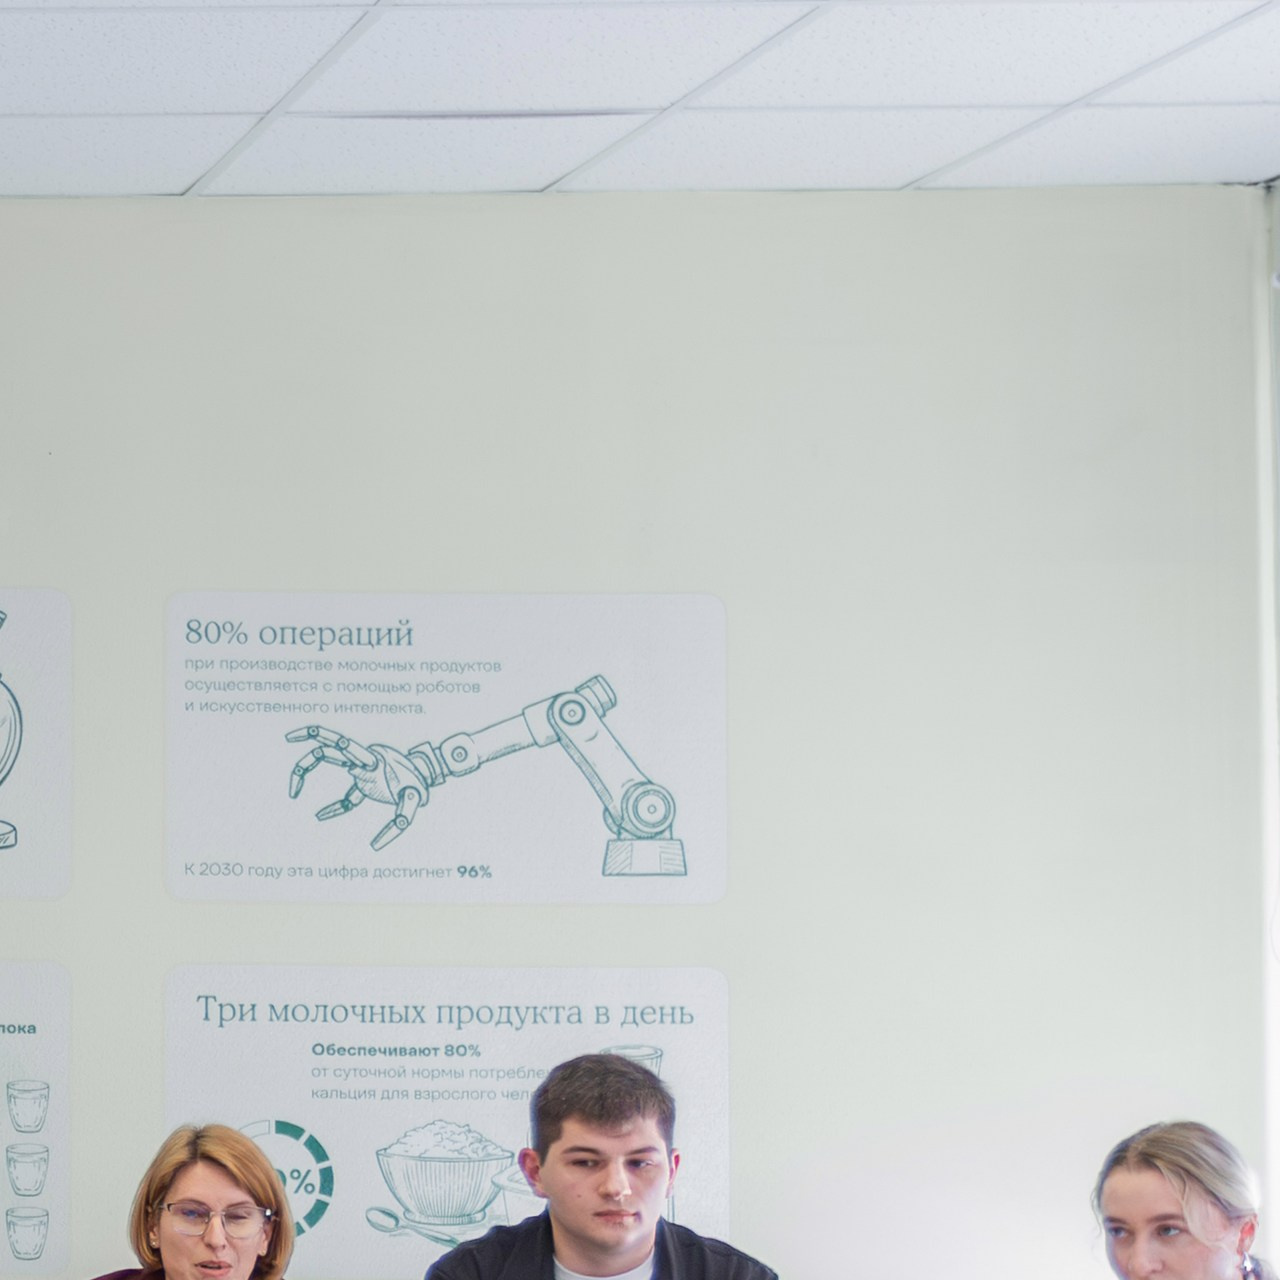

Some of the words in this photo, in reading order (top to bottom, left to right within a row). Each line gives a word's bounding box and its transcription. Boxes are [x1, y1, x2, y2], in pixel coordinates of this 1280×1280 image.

[186, 619, 248, 644] 80%
[259, 619, 413, 651] операций
[185, 659, 214, 672] при
[220, 659, 333, 672] производстве
[338, 661, 415, 671] молочных
[420, 661, 502, 675] продуктов
[184, 680, 318, 694] осуществляется
[323, 681, 332, 692] с
[337, 683, 412, 694] помощью
[416, 680, 481, 696] роботов
[185, 702, 194, 711] и
[199, 701, 329, 715] искусственного
[334, 704, 426, 714] интеллекта.
[185, 863, 194, 875] К
[199, 862, 243, 877] 2030
[248, 867, 283, 879] году
[288, 867, 313, 877] эта
[318, 865, 368, 881] цифра
[373, 868, 452, 879] достигнет
[456, 865, 492, 879] 96%
[196, 995, 257, 1028] Три
[269, 1003, 425, 1024] молочных
[437, 1005, 582, 1031] продукта
[595, 1006, 610, 1024] в
[621, 1006, 694, 1027] день
[312, 1043, 440, 1057] Обеспечивают
[444, 1044, 481, 1057] 80%
[311, 1067, 329, 1077] от
[333, 1066, 406, 1081] суточной
[412, 1069, 464, 1081] нормы
[469, 1066, 549, 1081] потребле
[312, 1089, 376, 1100] кальция
[380, 1089, 409, 1100] для
[414, 1089, 496, 1102] взрослого
